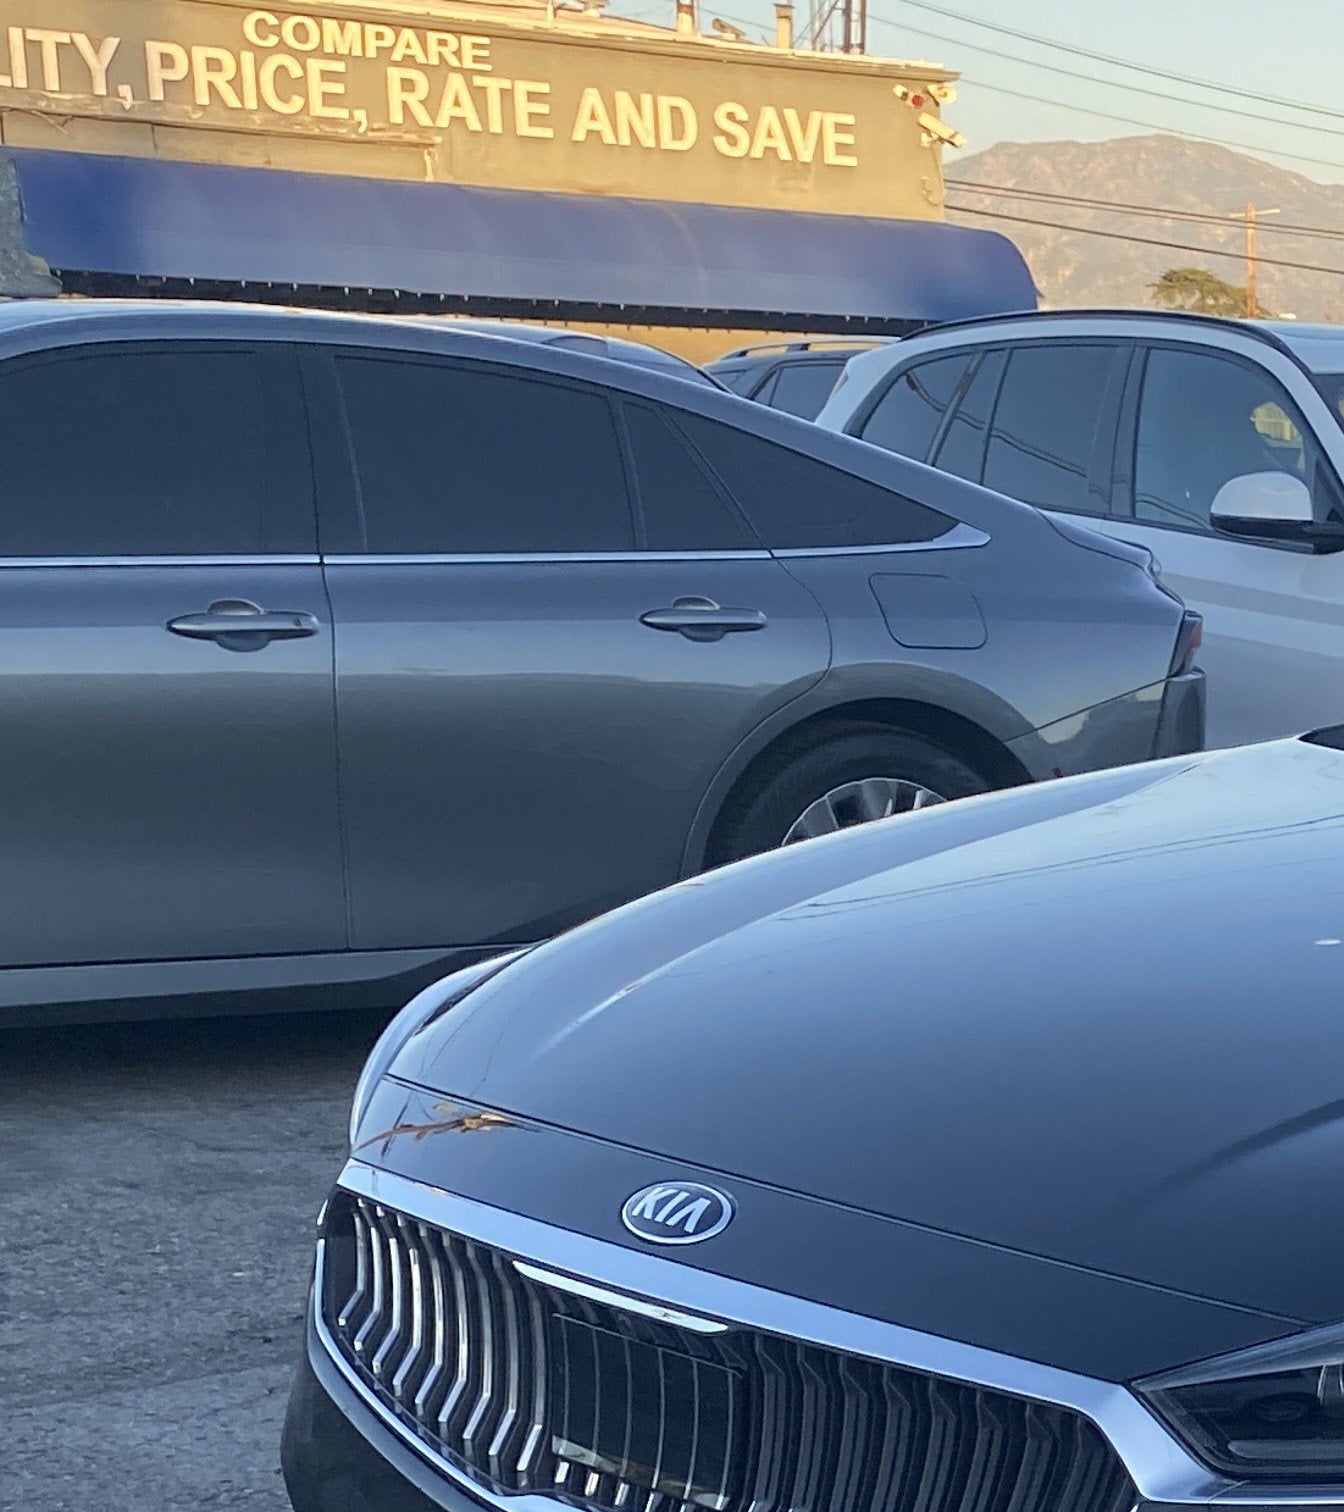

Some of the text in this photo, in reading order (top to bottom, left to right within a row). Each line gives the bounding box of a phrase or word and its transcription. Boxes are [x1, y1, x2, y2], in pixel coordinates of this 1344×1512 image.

[243, 11, 493, 72] COMPARE
[144, 40, 368, 133] PRICE,
[386, 66, 554, 139] RATE
[571, 87, 698, 151] AND
[713, 101, 859, 167] SAVE
[631, 1186, 711, 1234] KIA
